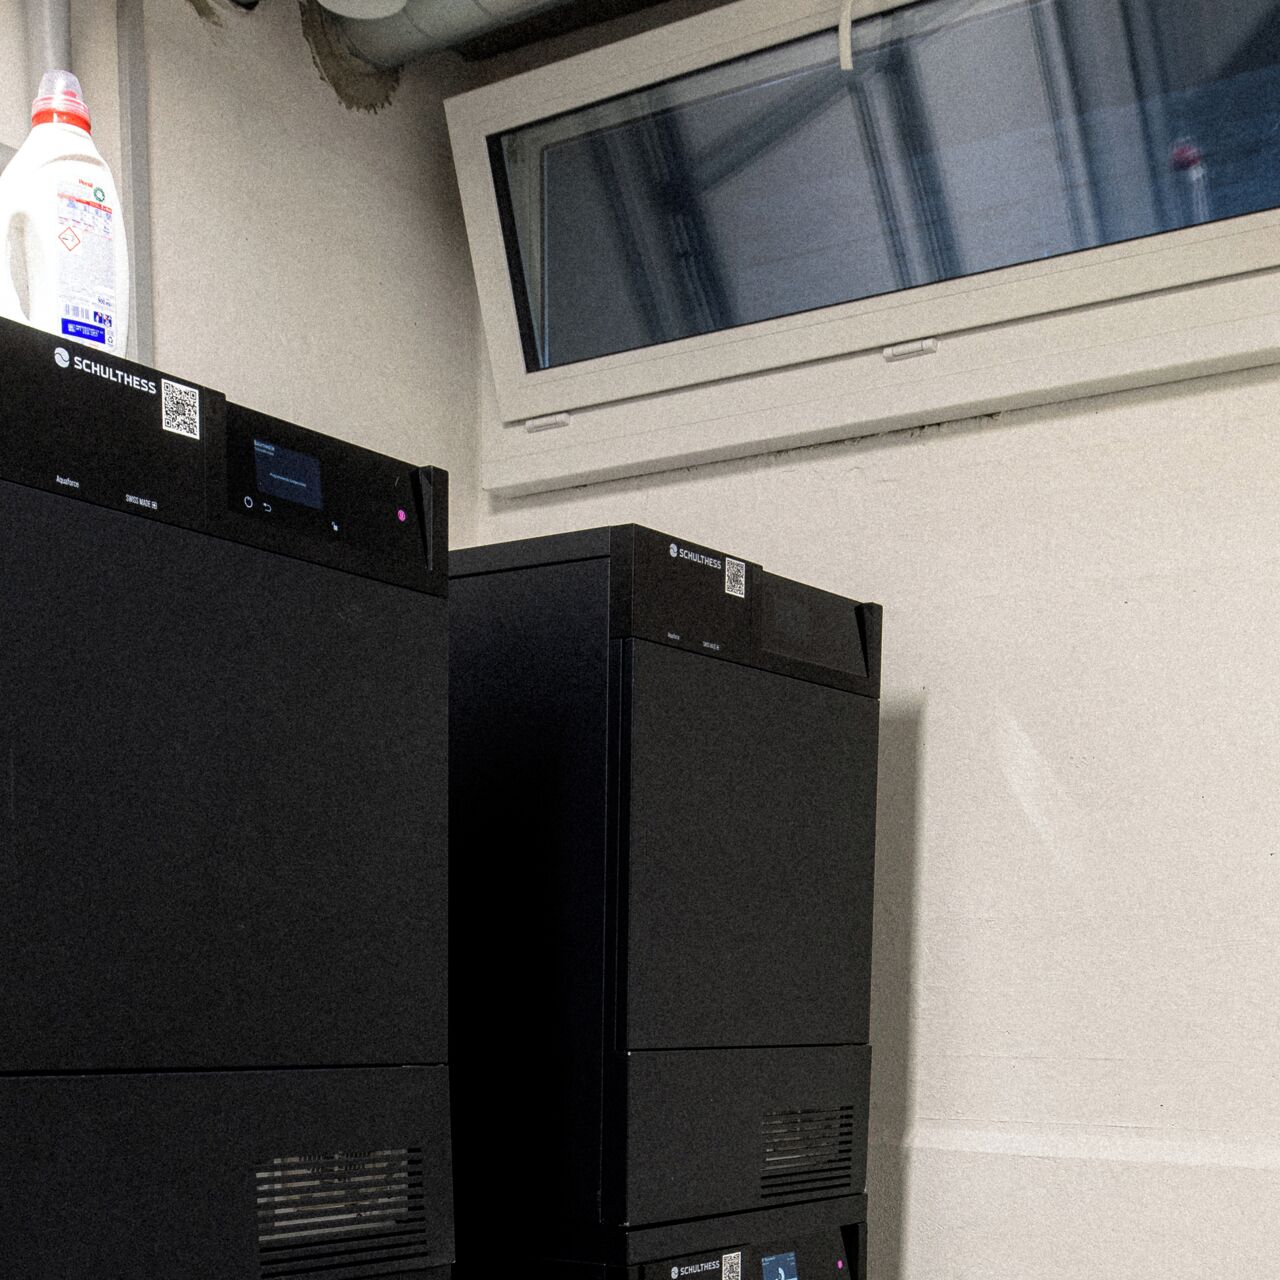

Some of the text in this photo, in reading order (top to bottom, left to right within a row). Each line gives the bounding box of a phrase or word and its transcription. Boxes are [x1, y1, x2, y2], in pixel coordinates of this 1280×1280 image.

[74, 356, 157, 395] SCHULTHESS
[679, 548, 722, 569] SCHULTHESS
[680, 1260, 720, 1276] SCHULTHESS
